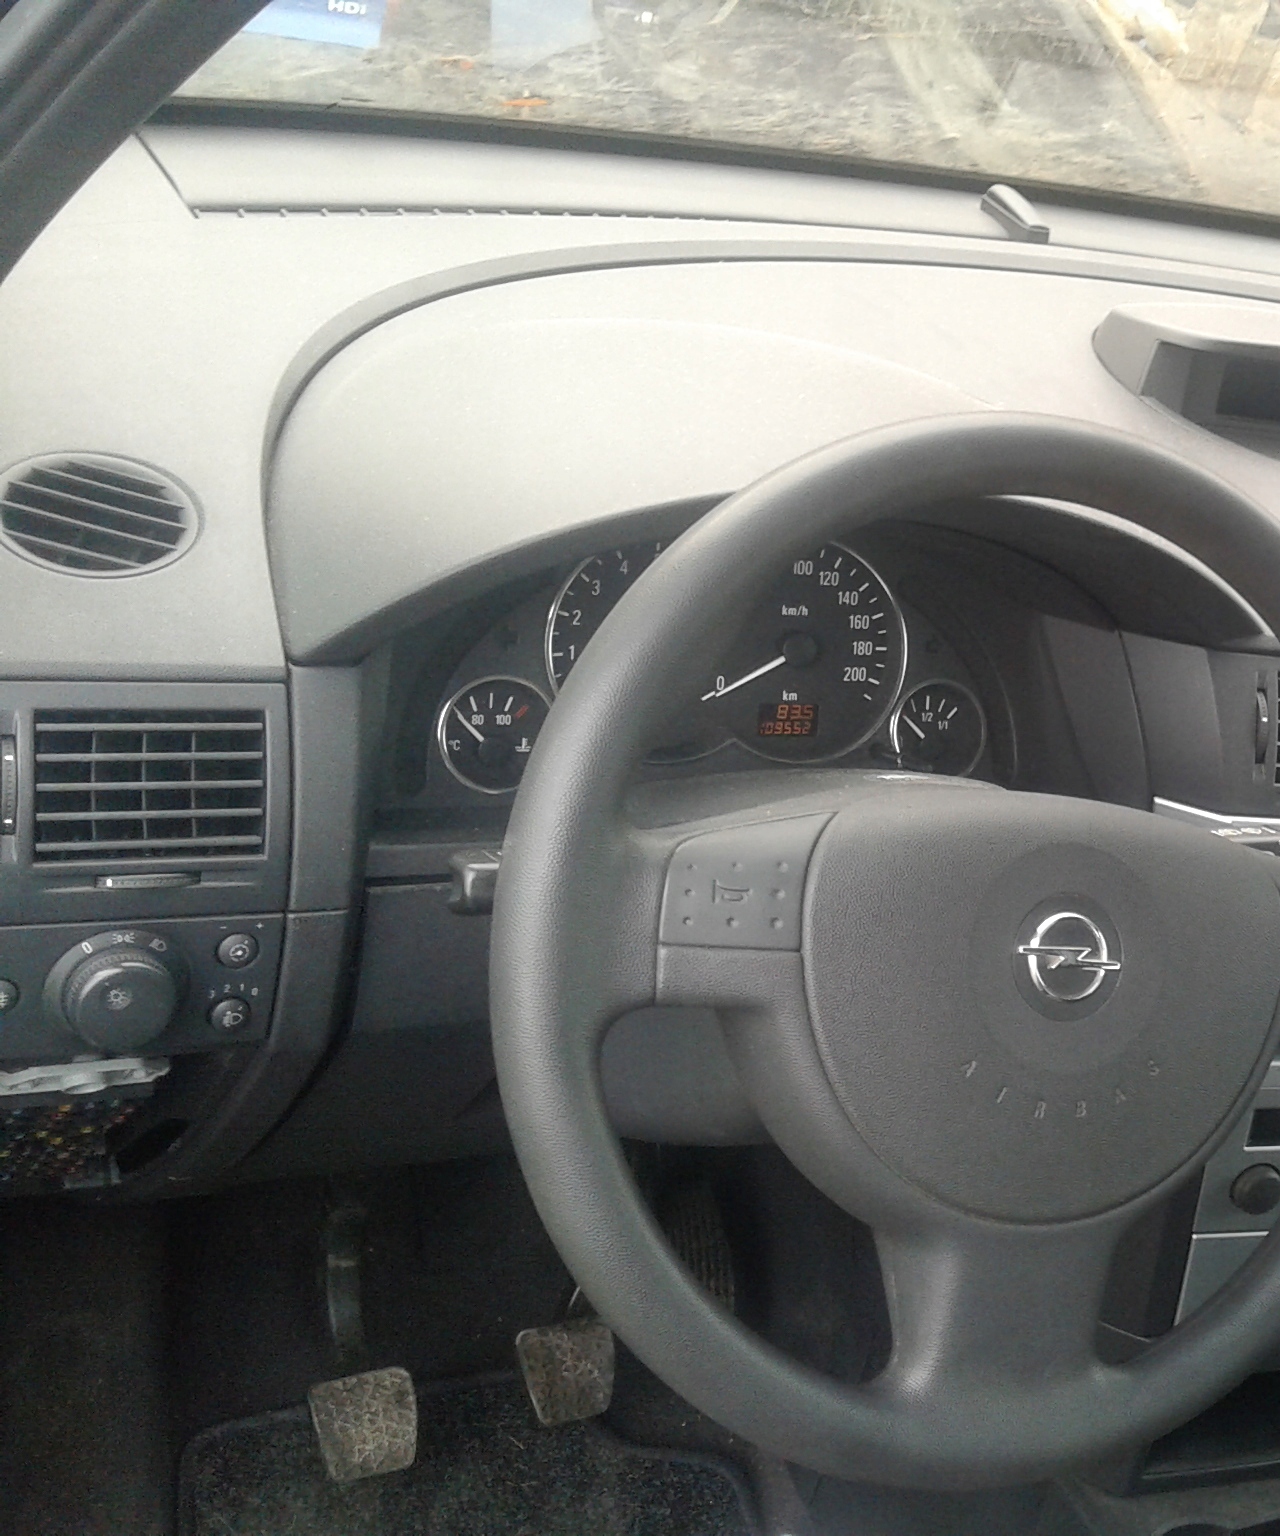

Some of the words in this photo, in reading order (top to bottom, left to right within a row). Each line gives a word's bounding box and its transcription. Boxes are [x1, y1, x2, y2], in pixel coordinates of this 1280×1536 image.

[619, 560, 629, 575] 4
[794, 560, 814, 575] 100
[819, 571, 839, 587] 120
[591, 579, 601, 596] 3
[838, 591, 859, 606] 140
[571, 609, 582, 626] 2
[781, 605, 809, 617] km/h
[849, 614, 870, 630] 160
[568, 644, 576, 661] 1
[852, 641, 873, 656] 180
[843, 666, 867, 682] 200
[716, 675, 725, 691] 0
[782, 690, 798, 702] km
[471, 714, 485, 726] 80
[495, 714, 512, 726] 100
[921, 711, 934, 723] 1/2
[223, 984, 232, 993] 2
